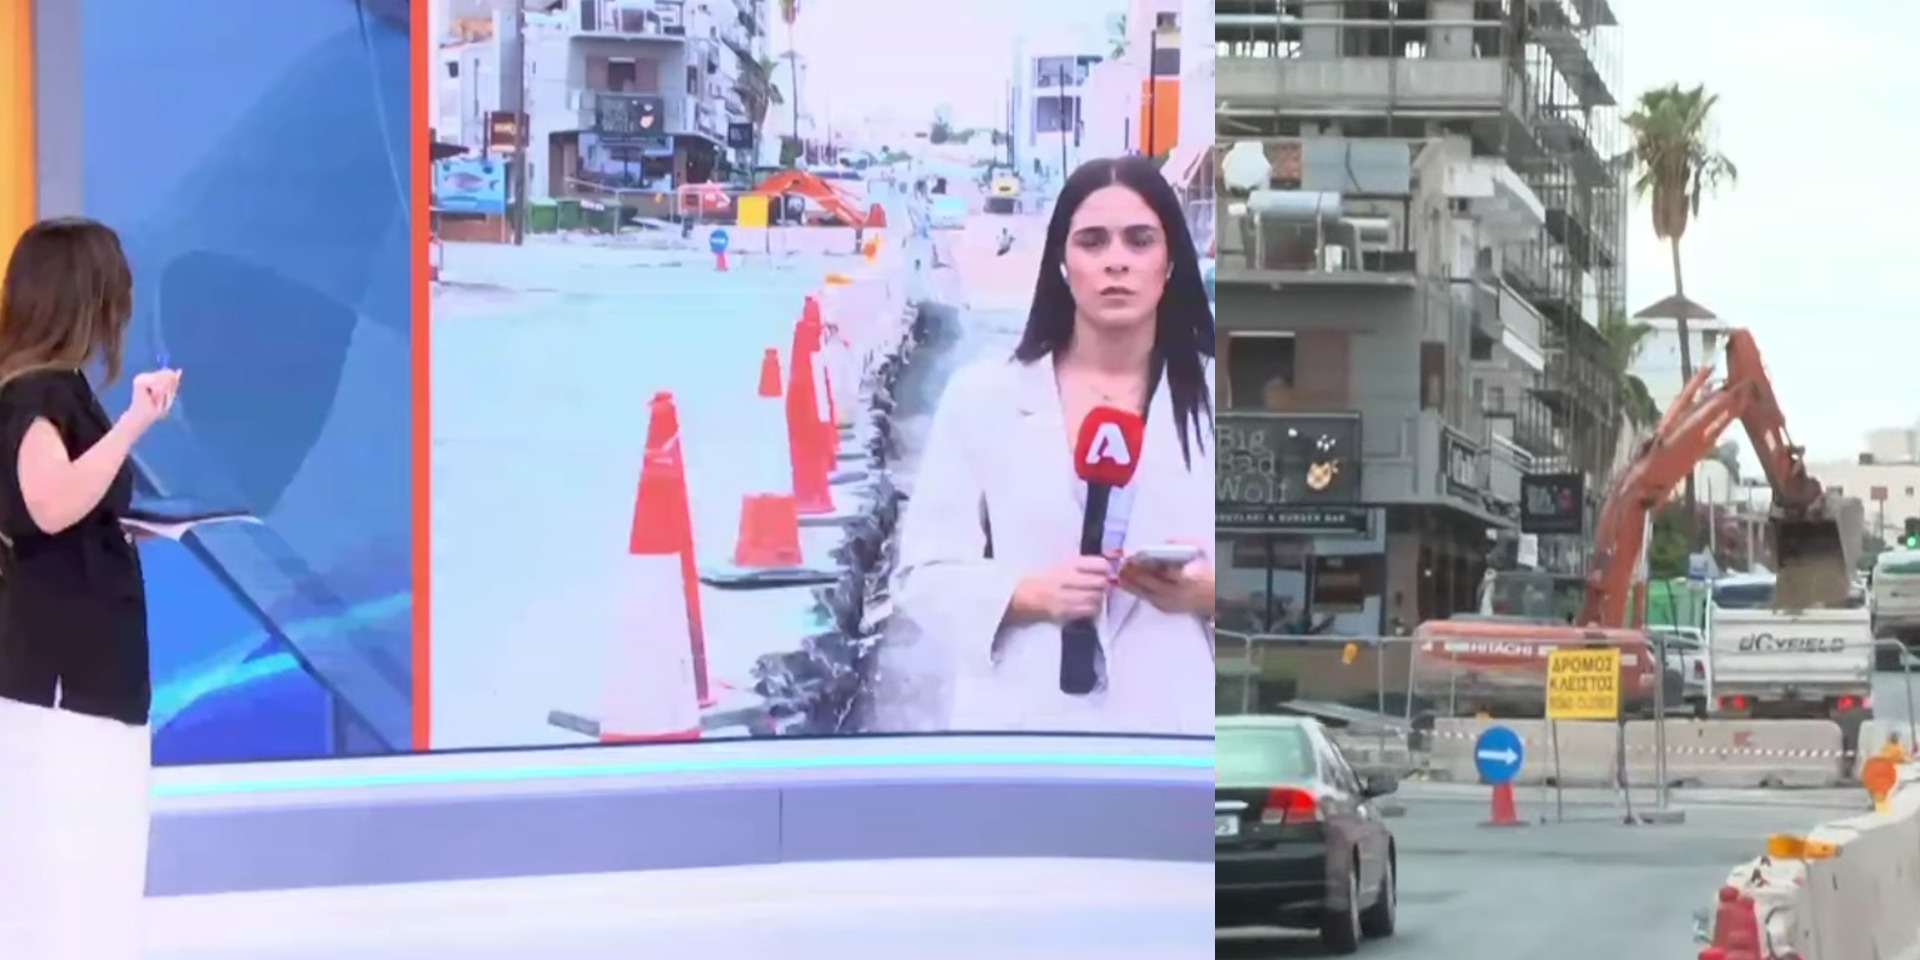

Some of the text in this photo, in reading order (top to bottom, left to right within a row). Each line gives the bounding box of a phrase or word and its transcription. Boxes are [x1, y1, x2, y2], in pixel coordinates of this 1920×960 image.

[1085, 422, 1132, 466] A
[1216, 425, 1267, 455] Big
[1216, 451, 1276, 477] Bad
[1216, 476, 1288, 504] Wolf
[1324, 513, 1346, 523] BAR
[1471, 641, 1533, 656] HITACHI
[1551, 655, 1612, 674] ΔΡΟΜΟΣ
[1549, 675, 1613, 692] ΚΛΕΙΣΤΟΣ
